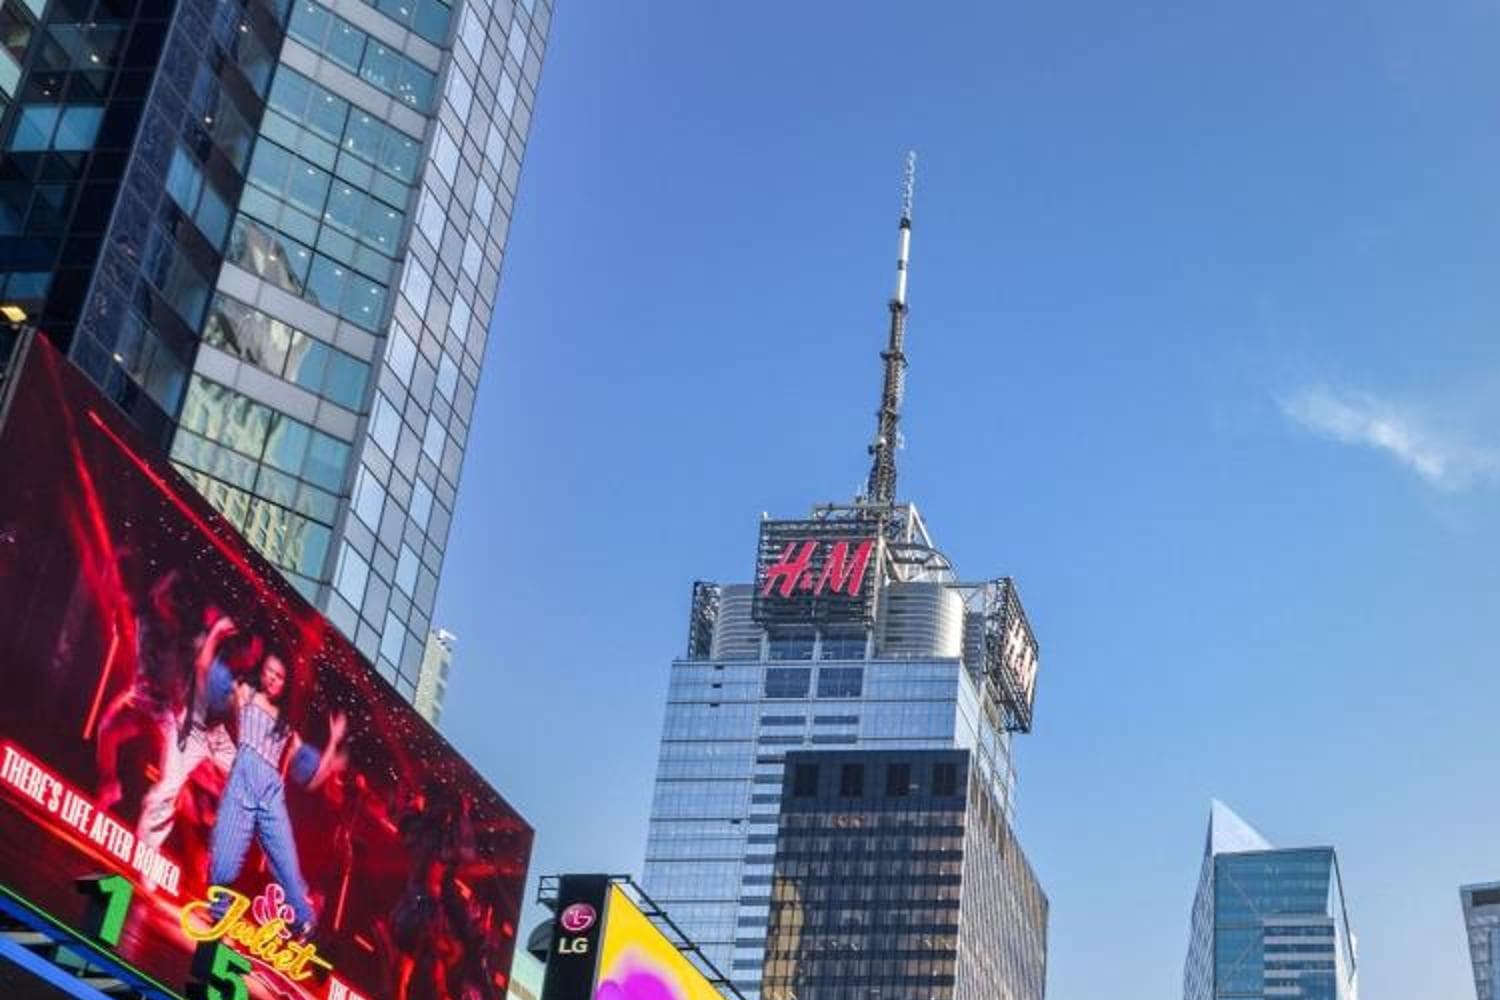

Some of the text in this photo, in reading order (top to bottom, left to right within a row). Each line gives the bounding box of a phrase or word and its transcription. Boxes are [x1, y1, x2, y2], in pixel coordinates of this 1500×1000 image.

[761, 540, 875, 598] H&M
[1, 746, 63, 812] THERE'S
[60, 789, 93, 834] LIFE
[88, 811, 134, 863] AFTER
[559, 937, 588, 954] LG
